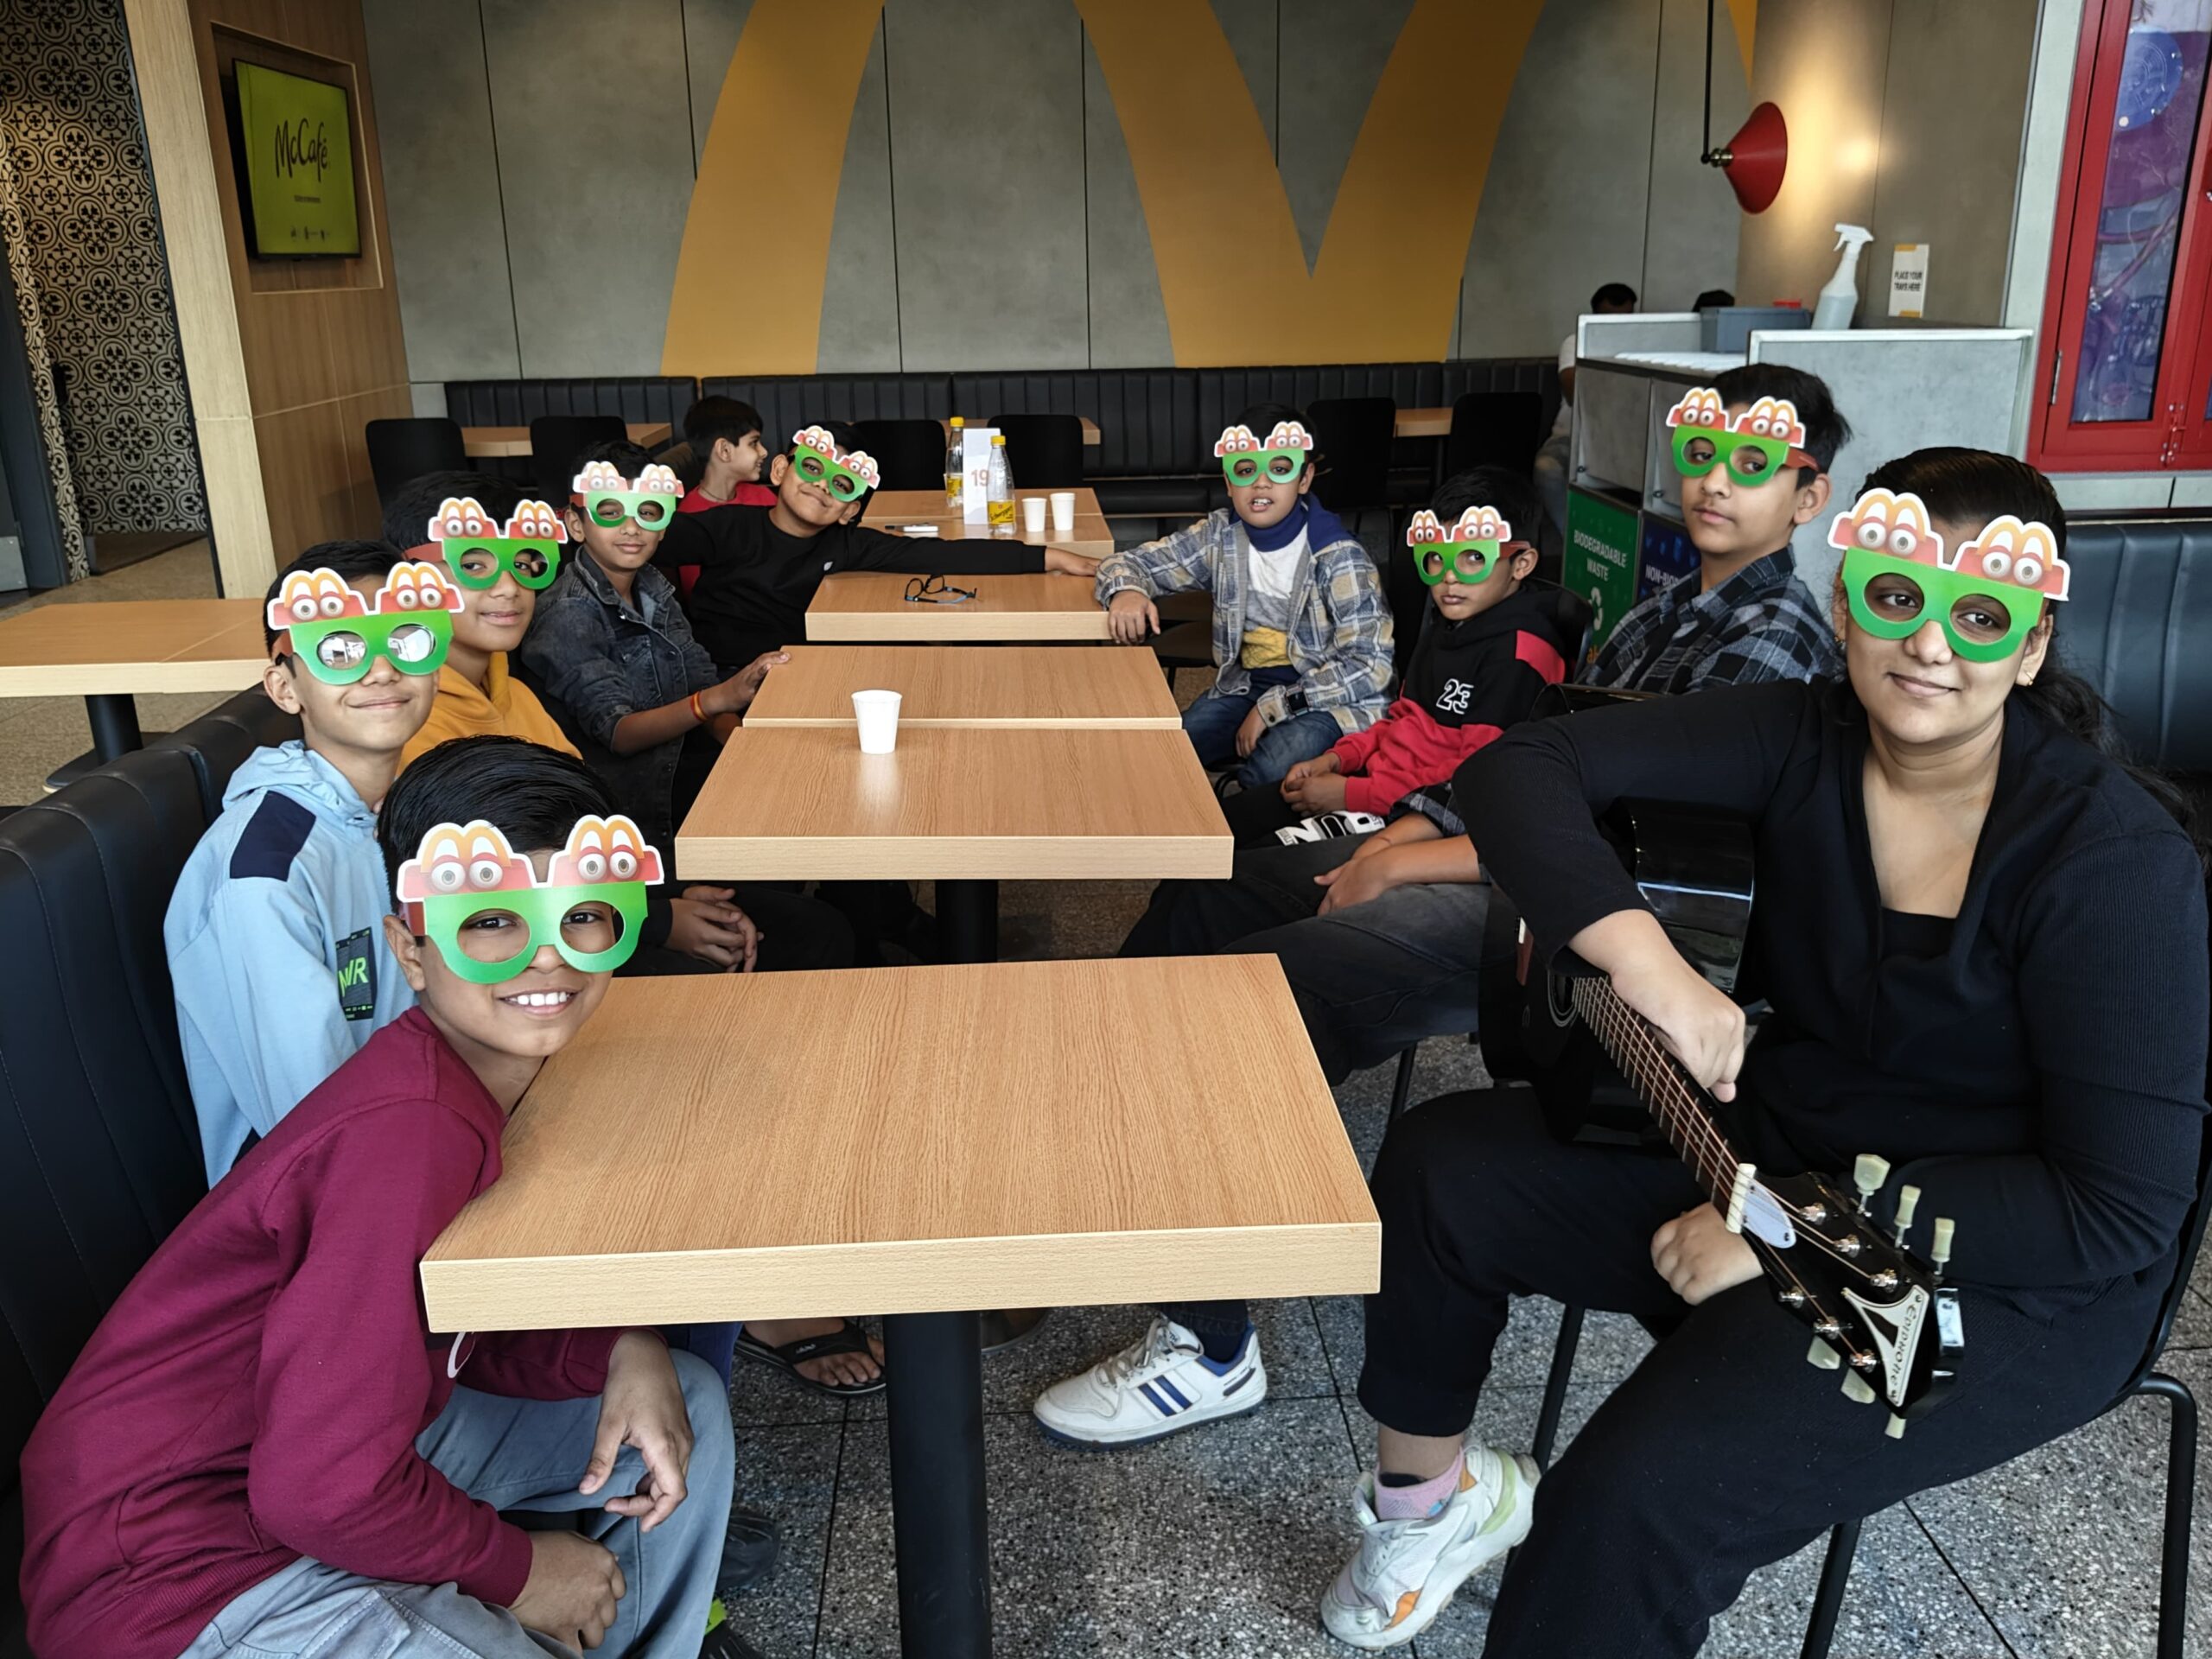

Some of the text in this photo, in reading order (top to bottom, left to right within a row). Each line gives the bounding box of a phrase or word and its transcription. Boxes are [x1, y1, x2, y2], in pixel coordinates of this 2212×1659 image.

[275, 118, 328, 183] McCafé
[1894, 270, 1923, 281] PLACE YOUR
[1909, 283, 1921, 292] HERE
[971, 469, 989, 486] 19
[1573, 529, 1626, 569] BIODEGRADABLE
[1586, 557, 1609, 582] WASTE
[1436, 678, 1474, 715] 23
